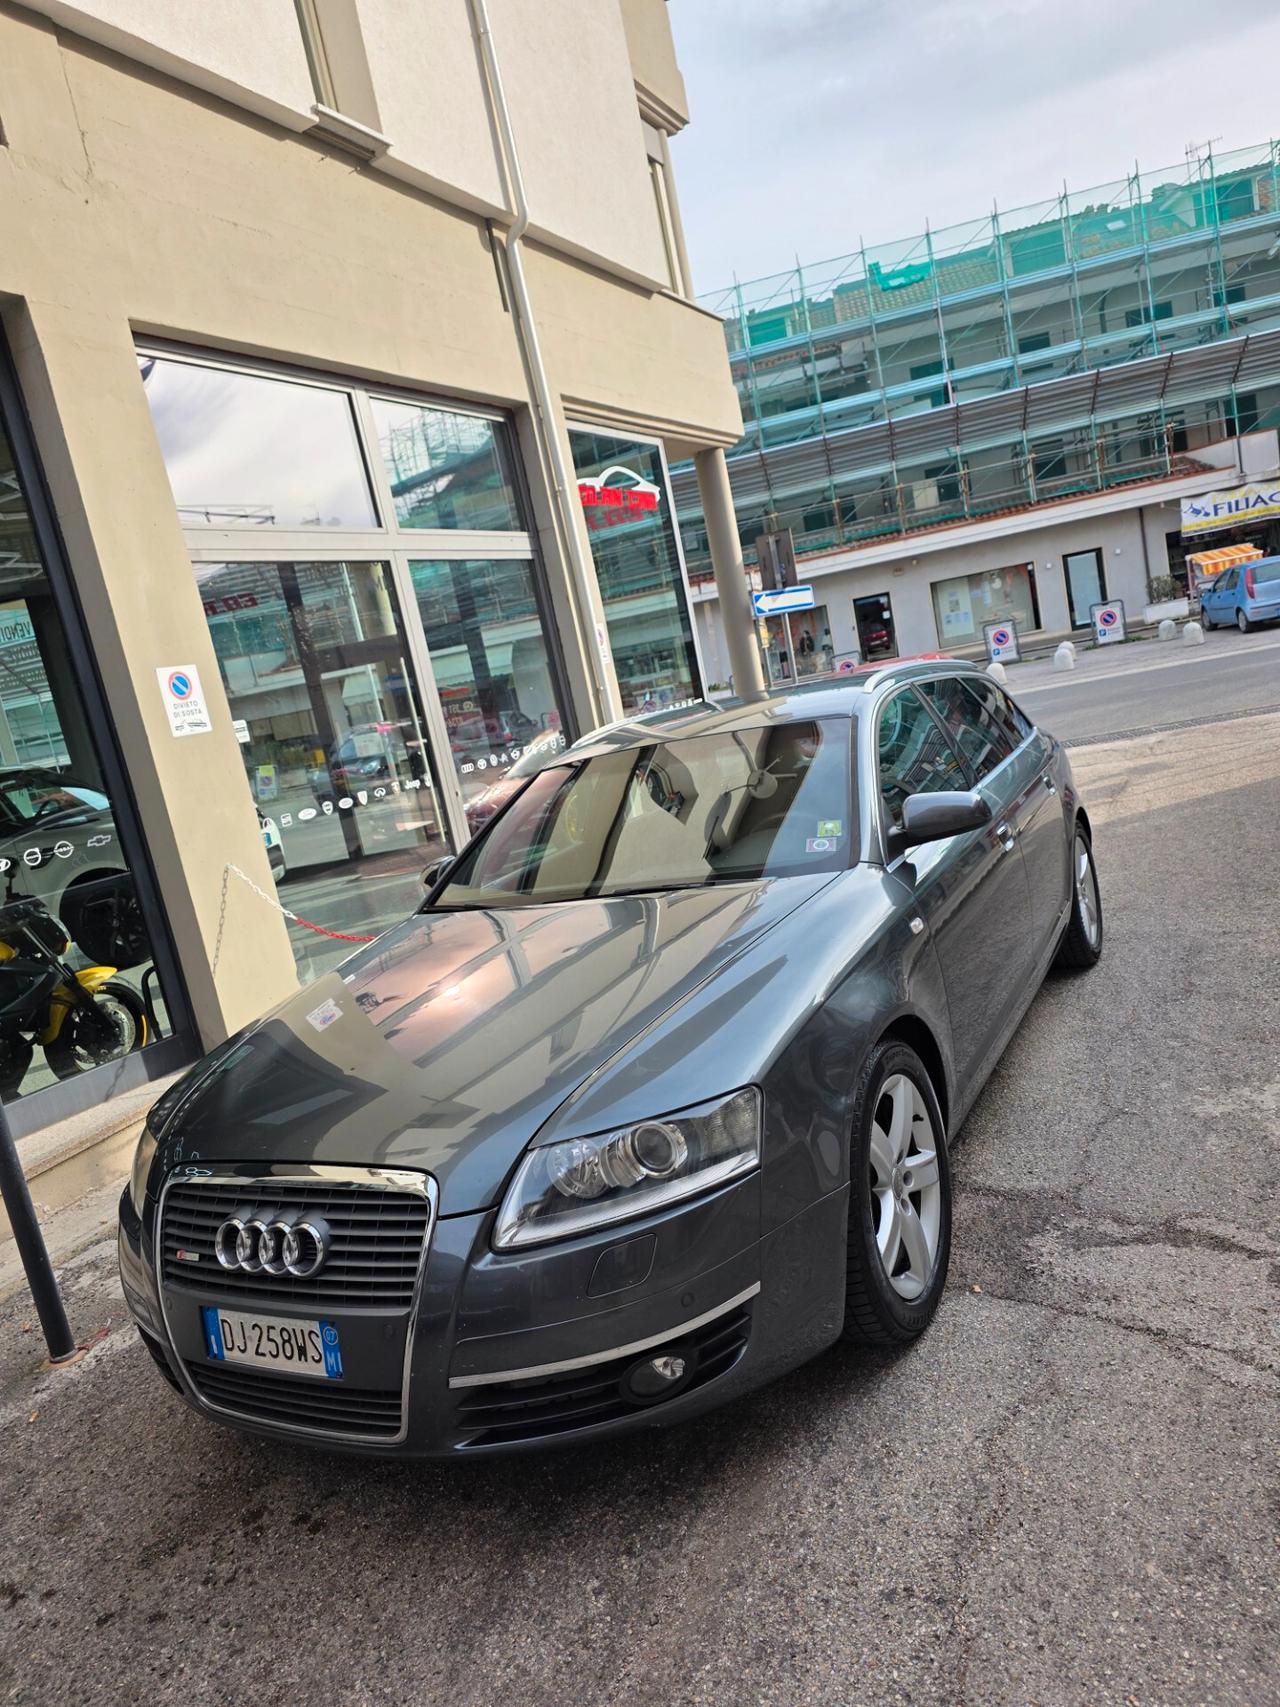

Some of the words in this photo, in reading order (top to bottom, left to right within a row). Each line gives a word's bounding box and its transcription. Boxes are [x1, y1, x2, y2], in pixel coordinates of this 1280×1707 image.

[173, 700, 199, 710] DIVIETO
[173, 711, 181, 719] DI
[182, 708, 203, 718] SOSTA
[326, 1350, 343, 1373] MI
